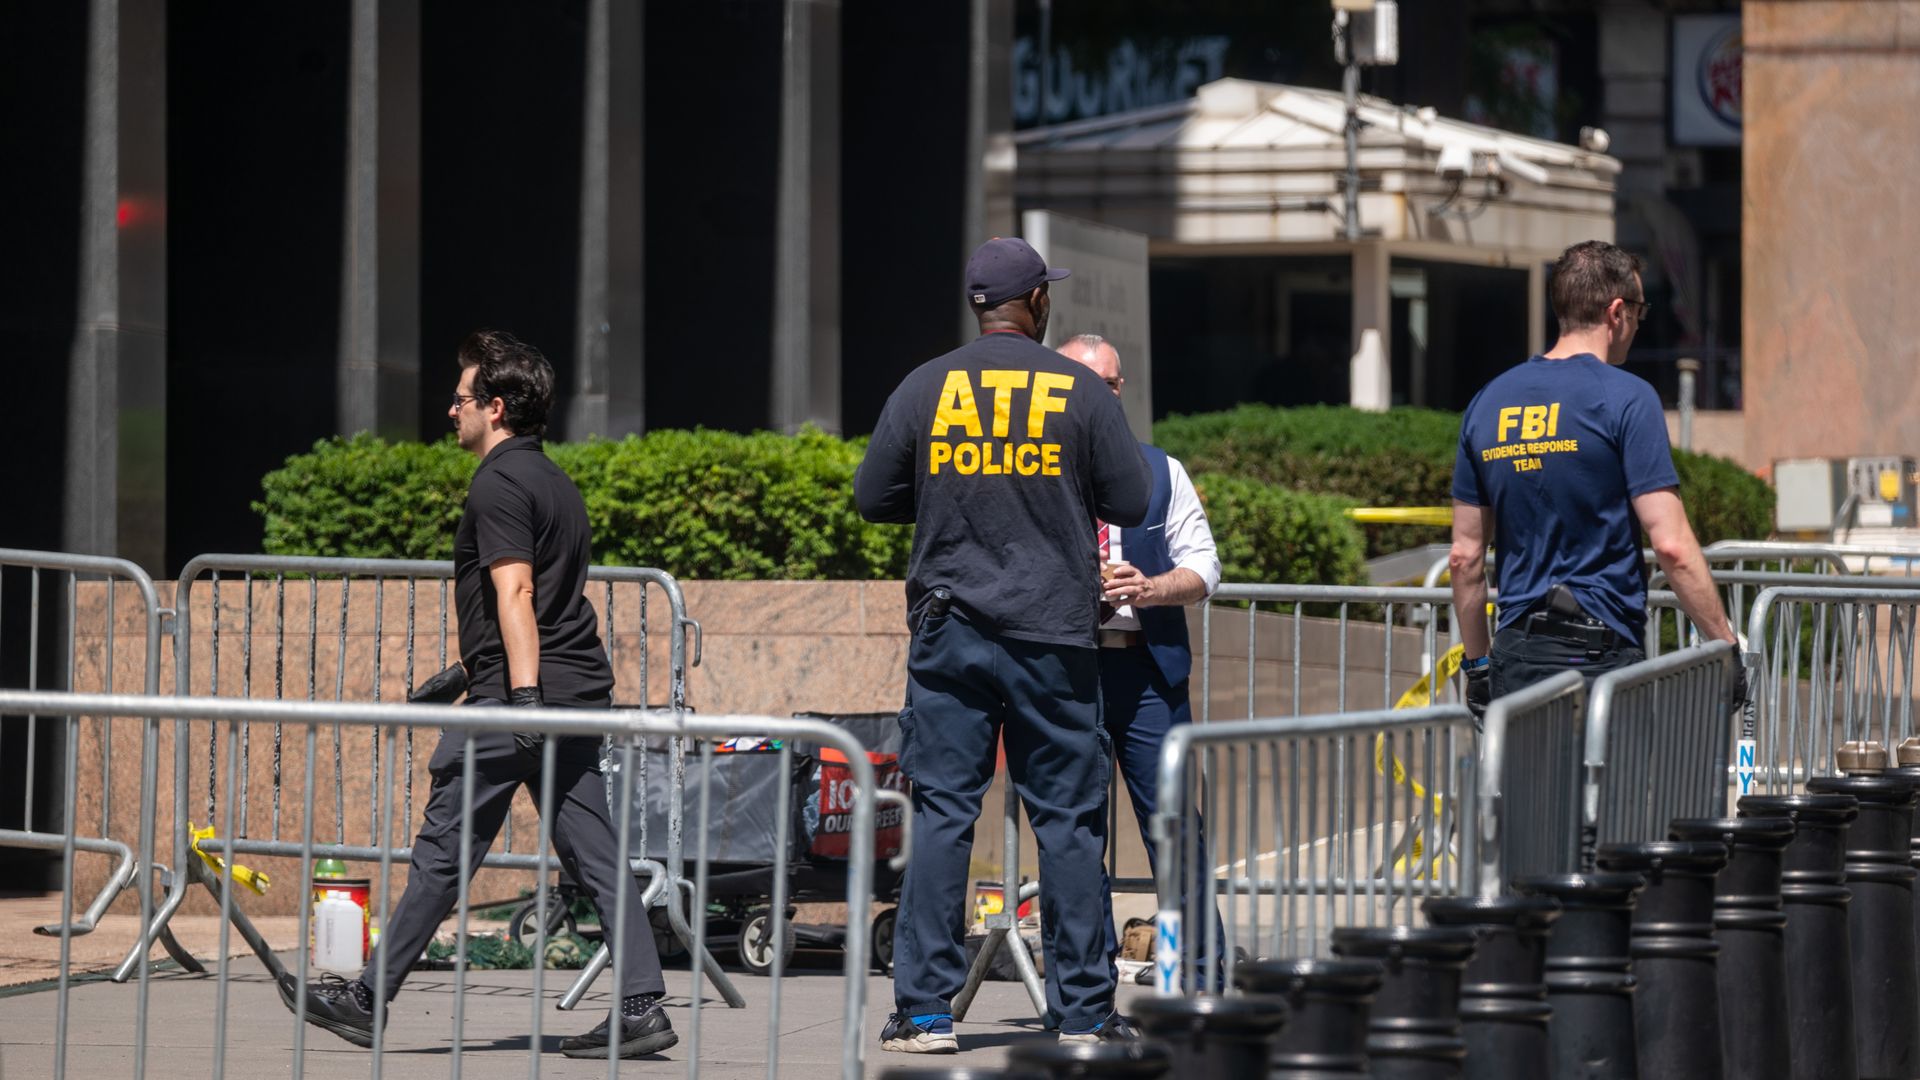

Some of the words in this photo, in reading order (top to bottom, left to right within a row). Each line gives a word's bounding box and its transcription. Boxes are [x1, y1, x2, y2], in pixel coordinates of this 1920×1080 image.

[931, 370, 1075, 438] ATF
[1497, 402, 1560, 443] FBI
[930, 441, 1062, 477] POLICE
[1482, 443, 1528, 462] EVIDENCE
[1526, 439, 1579, 456] RESPONSE
[1513, 457, 1543, 473] TEAM
